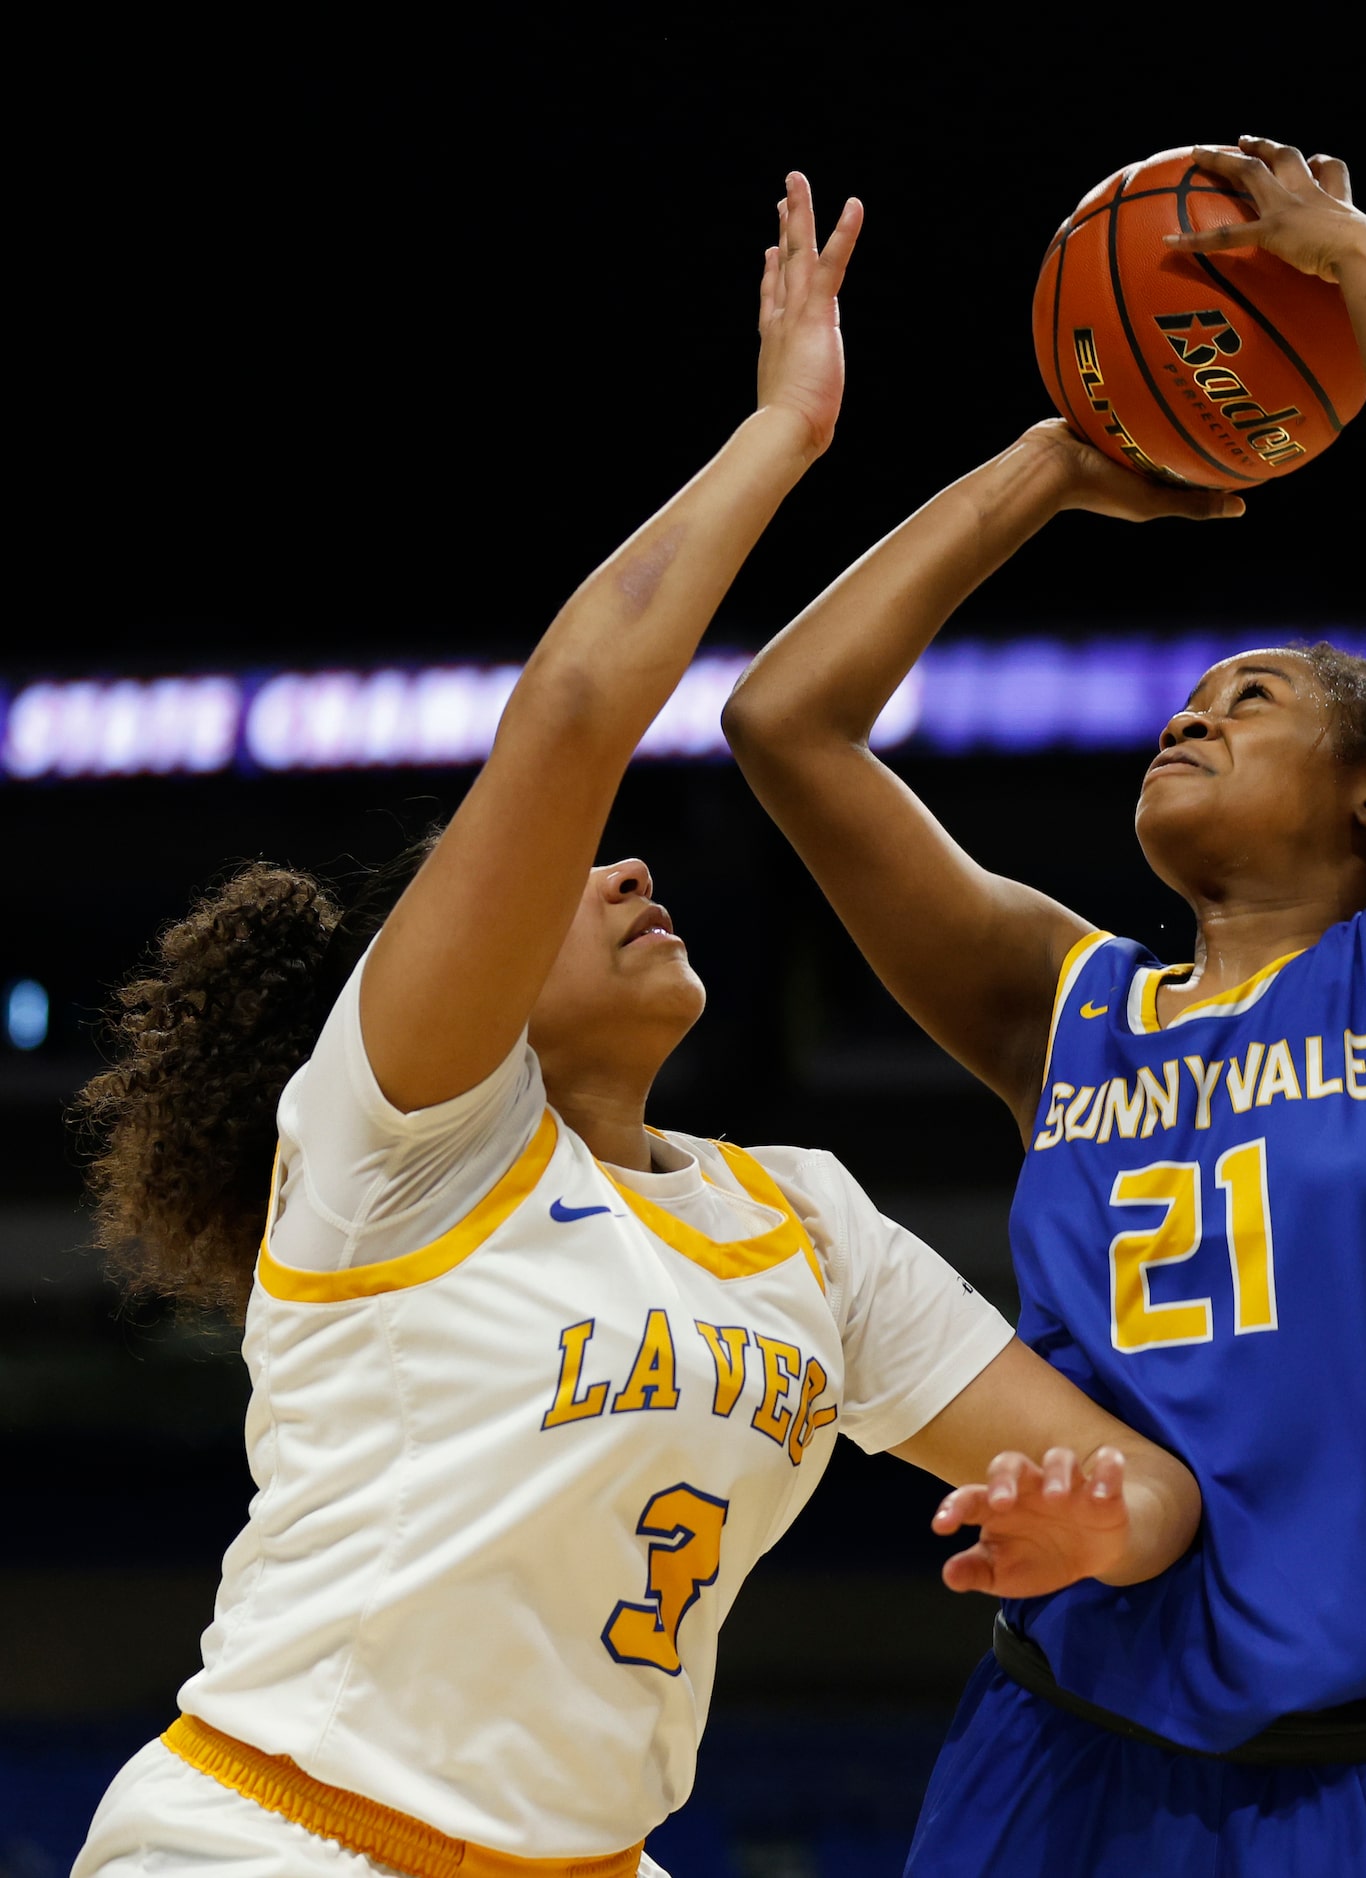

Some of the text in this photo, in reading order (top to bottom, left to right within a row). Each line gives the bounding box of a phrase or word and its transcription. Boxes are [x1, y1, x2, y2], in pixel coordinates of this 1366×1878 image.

[1153, 309, 1306, 467] Baden
[1109, 1137, 1278, 1354] 21
[540, 1309, 837, 1467] LA VEG
[600, 1481, 730, 1677] 3
